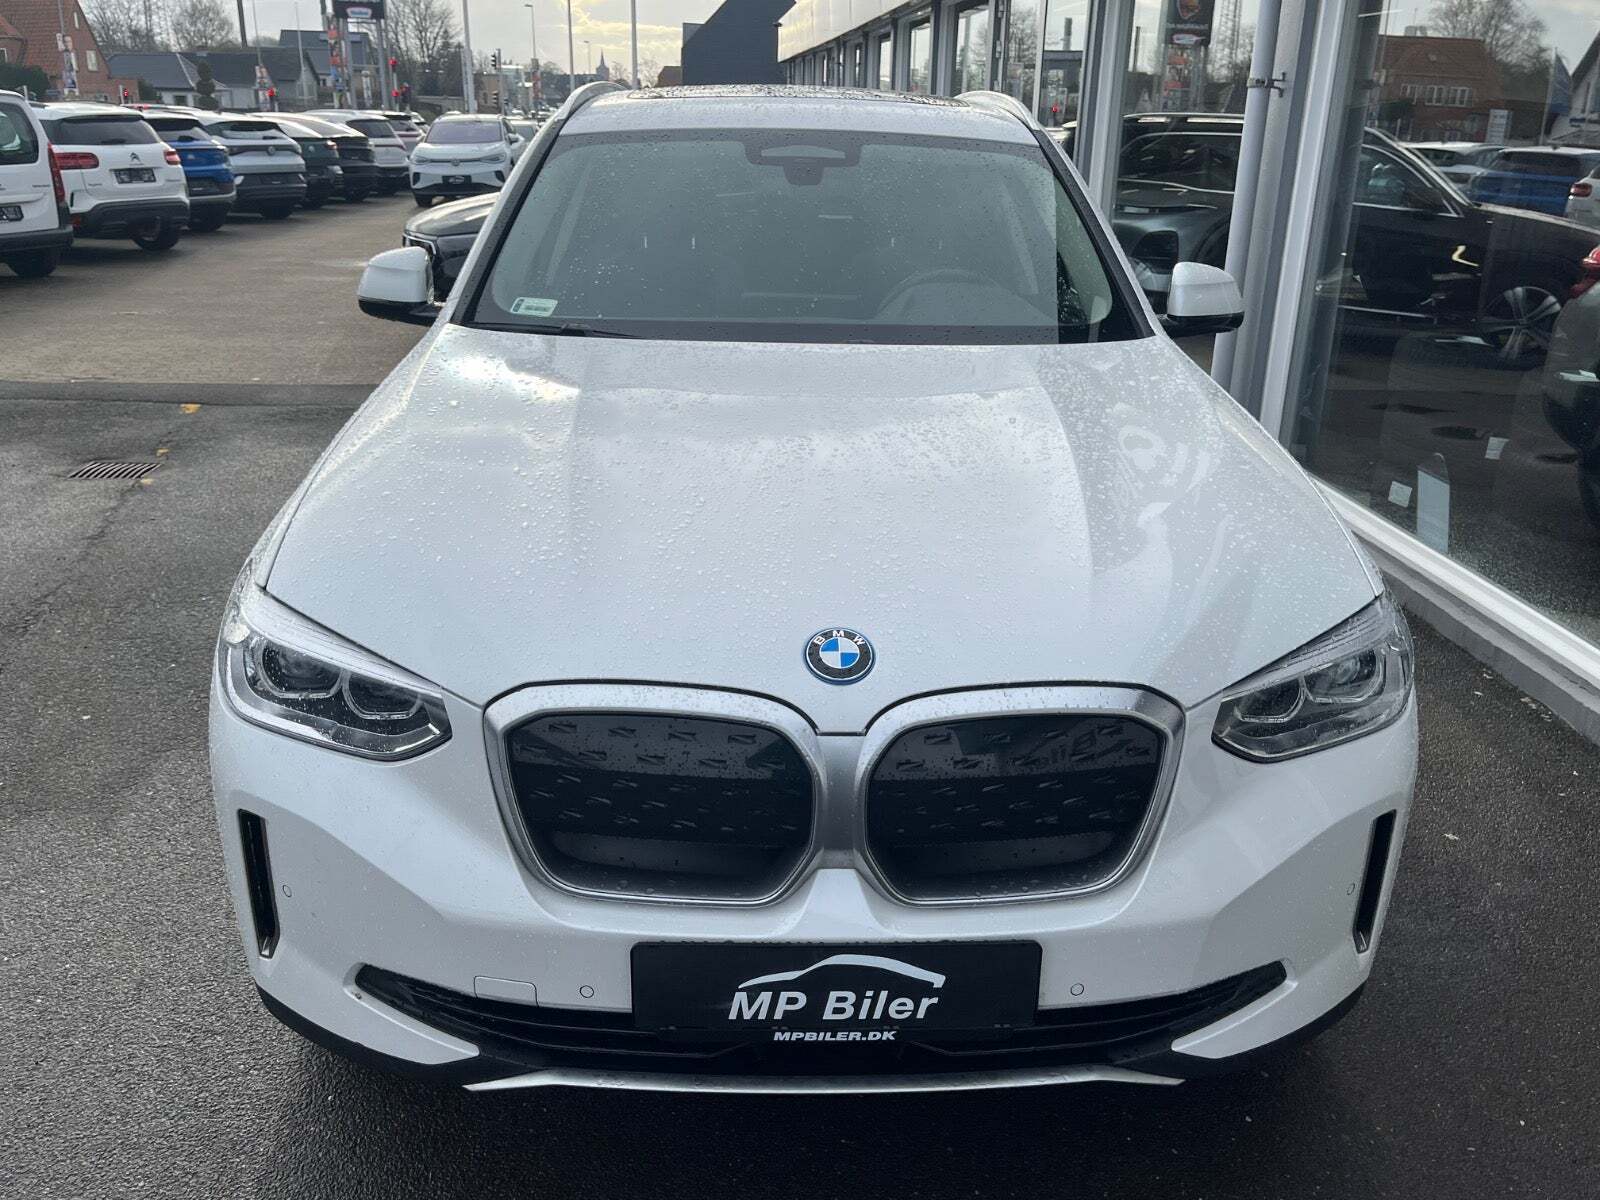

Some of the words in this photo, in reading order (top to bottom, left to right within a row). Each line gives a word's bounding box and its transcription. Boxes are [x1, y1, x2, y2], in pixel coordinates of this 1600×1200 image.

[813, 629, 866, 646] BMW
[728, 991, 807, 1020] MP
[822, 990, 939, 1020] Biler
[773, 1030, 897, 1042] MPBILER.DK
